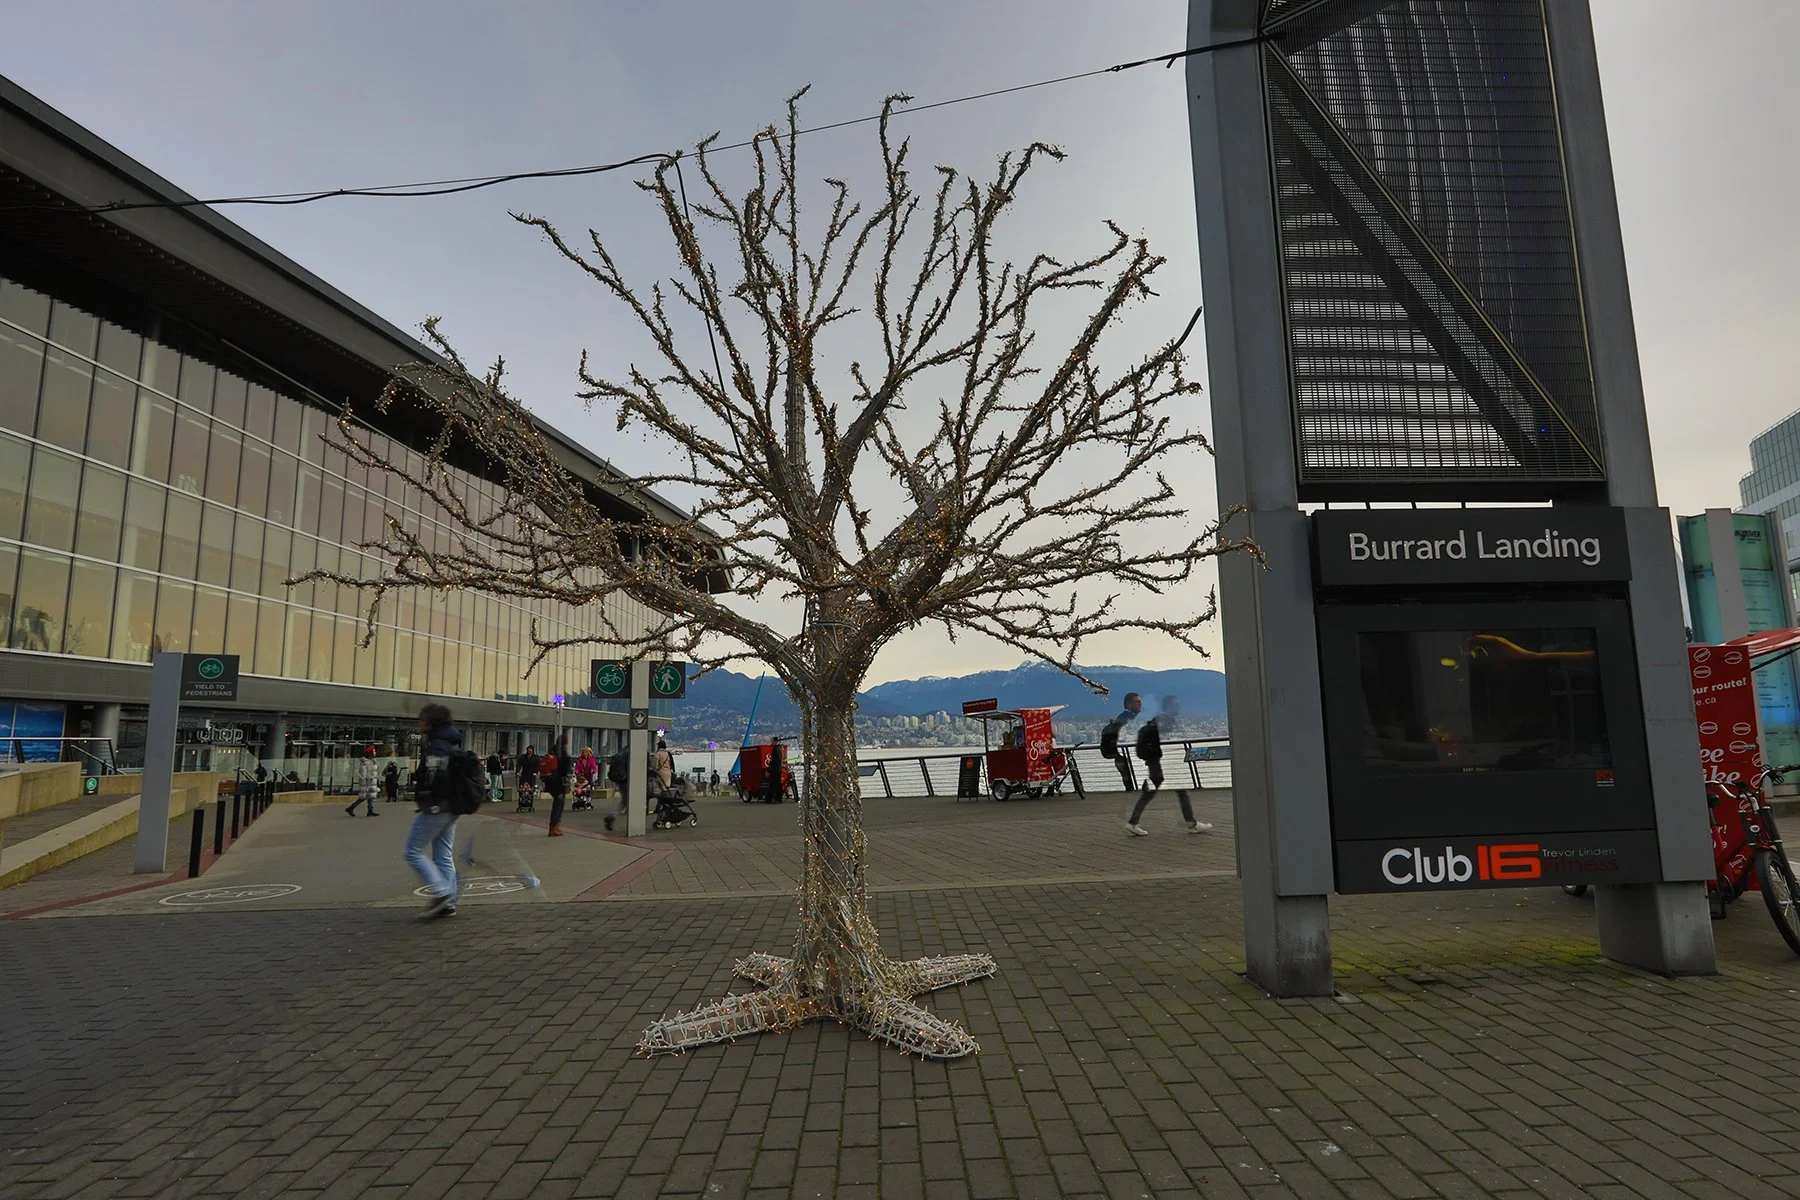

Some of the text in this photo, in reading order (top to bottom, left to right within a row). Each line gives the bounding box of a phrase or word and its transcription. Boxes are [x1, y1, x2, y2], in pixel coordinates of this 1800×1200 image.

[1350, 528, 1601, 566] Burrard Landing
[1711, 677, 1747, 691] route!
[1381, 846, 1473, 885] Club
[1542, 849, 1576, 858] Trevor
[1578, 847, 1616, 857] Linden
